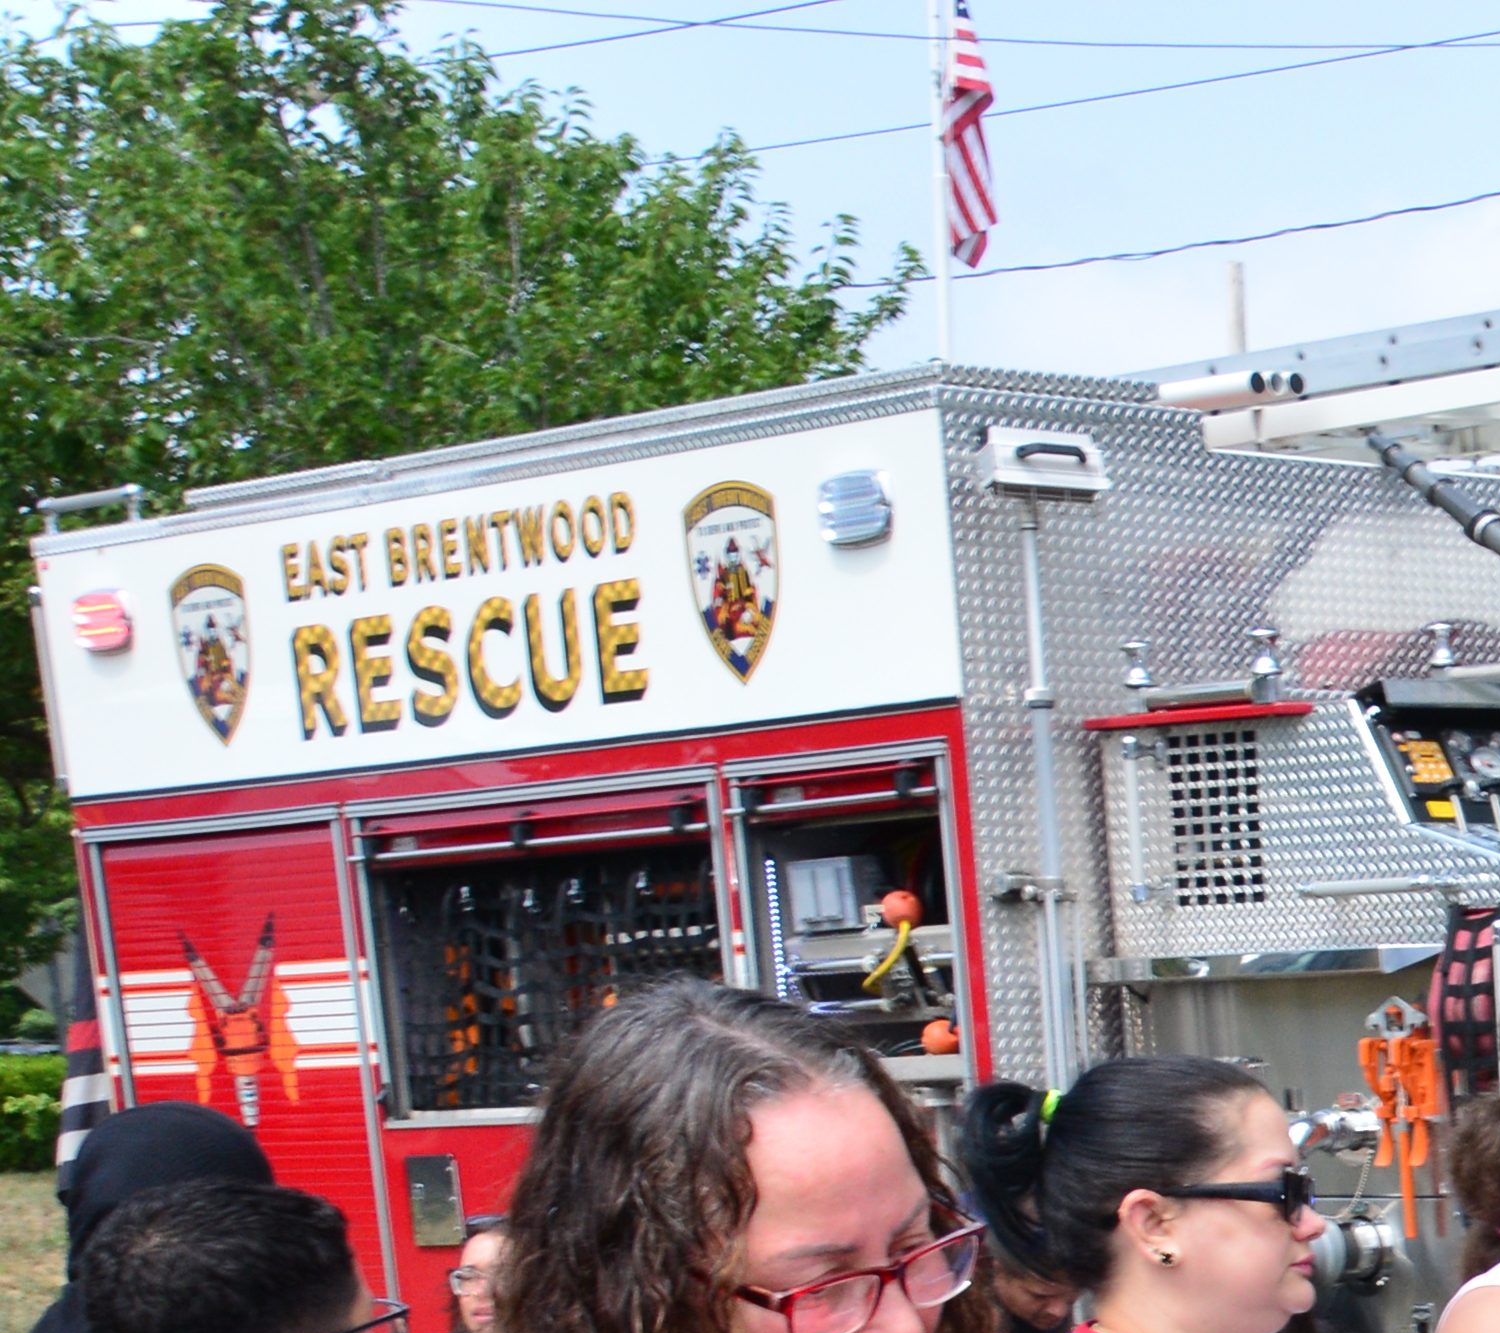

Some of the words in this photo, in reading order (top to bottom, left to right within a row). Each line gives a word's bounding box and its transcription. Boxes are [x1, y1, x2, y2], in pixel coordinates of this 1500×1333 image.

[282, 532, 369, 602] EAST
[386, 491, 636, 587] BRENTWOOD
[292, 578, 649, 741] RESCUE
